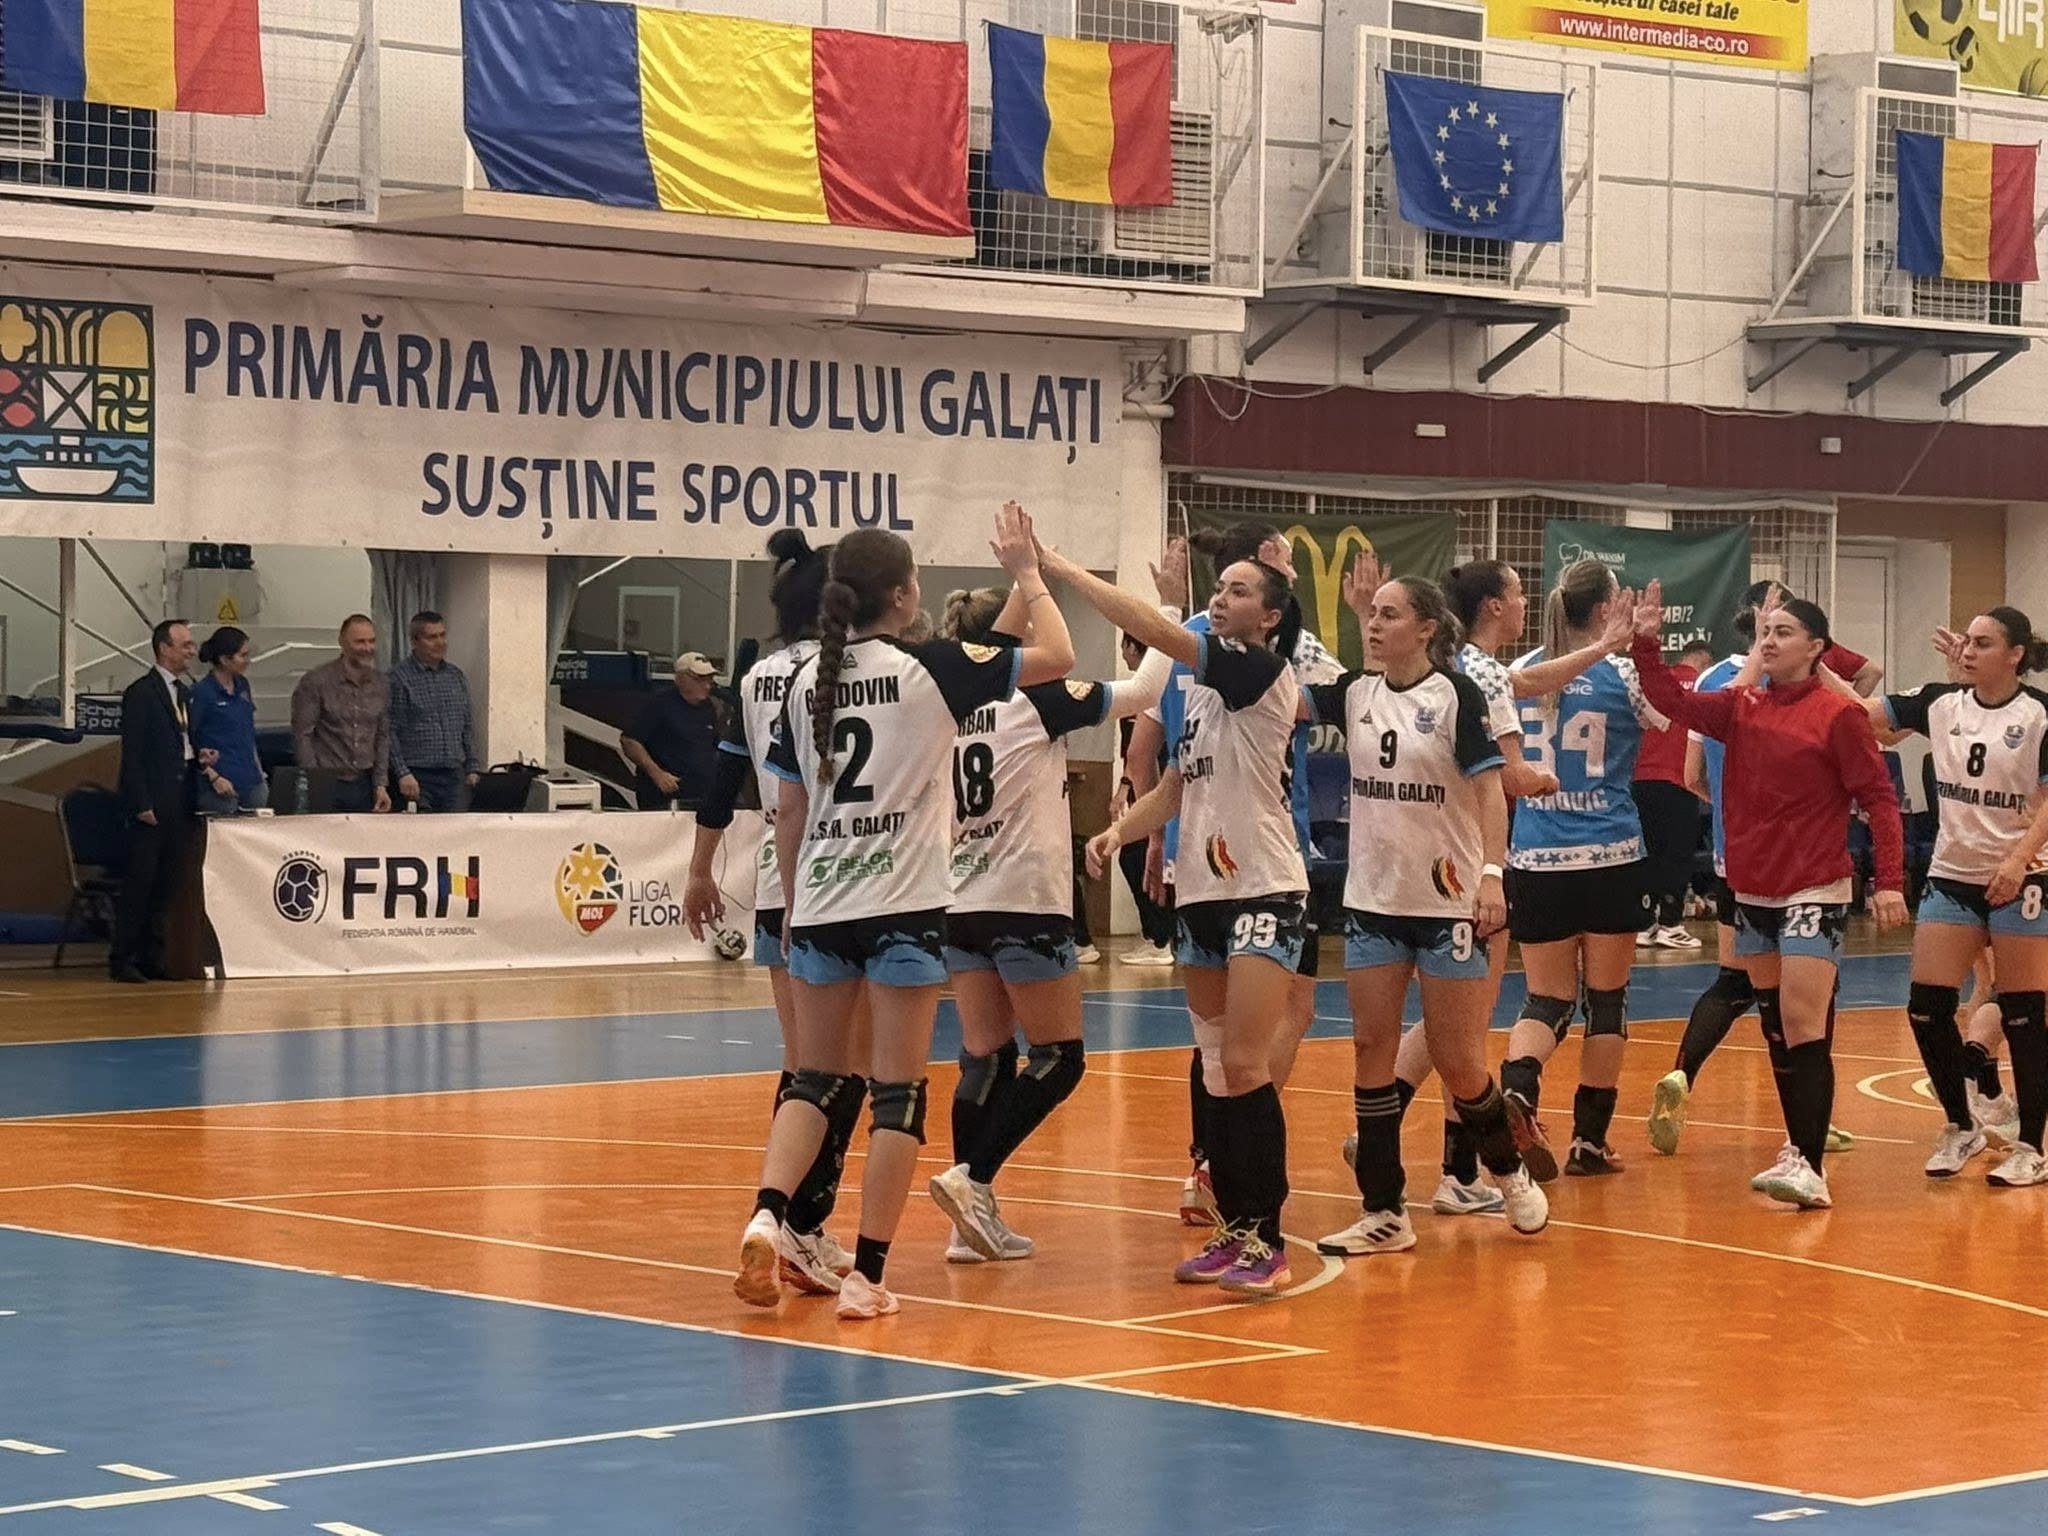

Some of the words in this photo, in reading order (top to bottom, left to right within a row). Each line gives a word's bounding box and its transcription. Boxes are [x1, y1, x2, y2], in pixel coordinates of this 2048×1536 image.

[1706, 3, 1739, 21] tale
[1560, 15, 1749, 55] www.intermedia-co.ro
[184, 314, 500, 413] PRIMĂRIA
[518, 345, 905, 433] MUNICIPIULUI
[920, 368, 1101, 464] GALAȚI
[421, 452, 657, 539] SUSȚINE
[682, 463, 914, 532] SPORTUL
[833, 716, 874, 805] 2
[1379, 729, 1398, 769] 9
[1966, 742, 1987, 777] 8
[343, 856, 480, 920] FRH
[629, 880, 673, 903] LIGA
[2021, 886, 2042, 920] 8
[1232, 912, 1278, 949] 99
[1784, 904, 1822, 939] 23
[1452, 922, 1473, 962] 9
